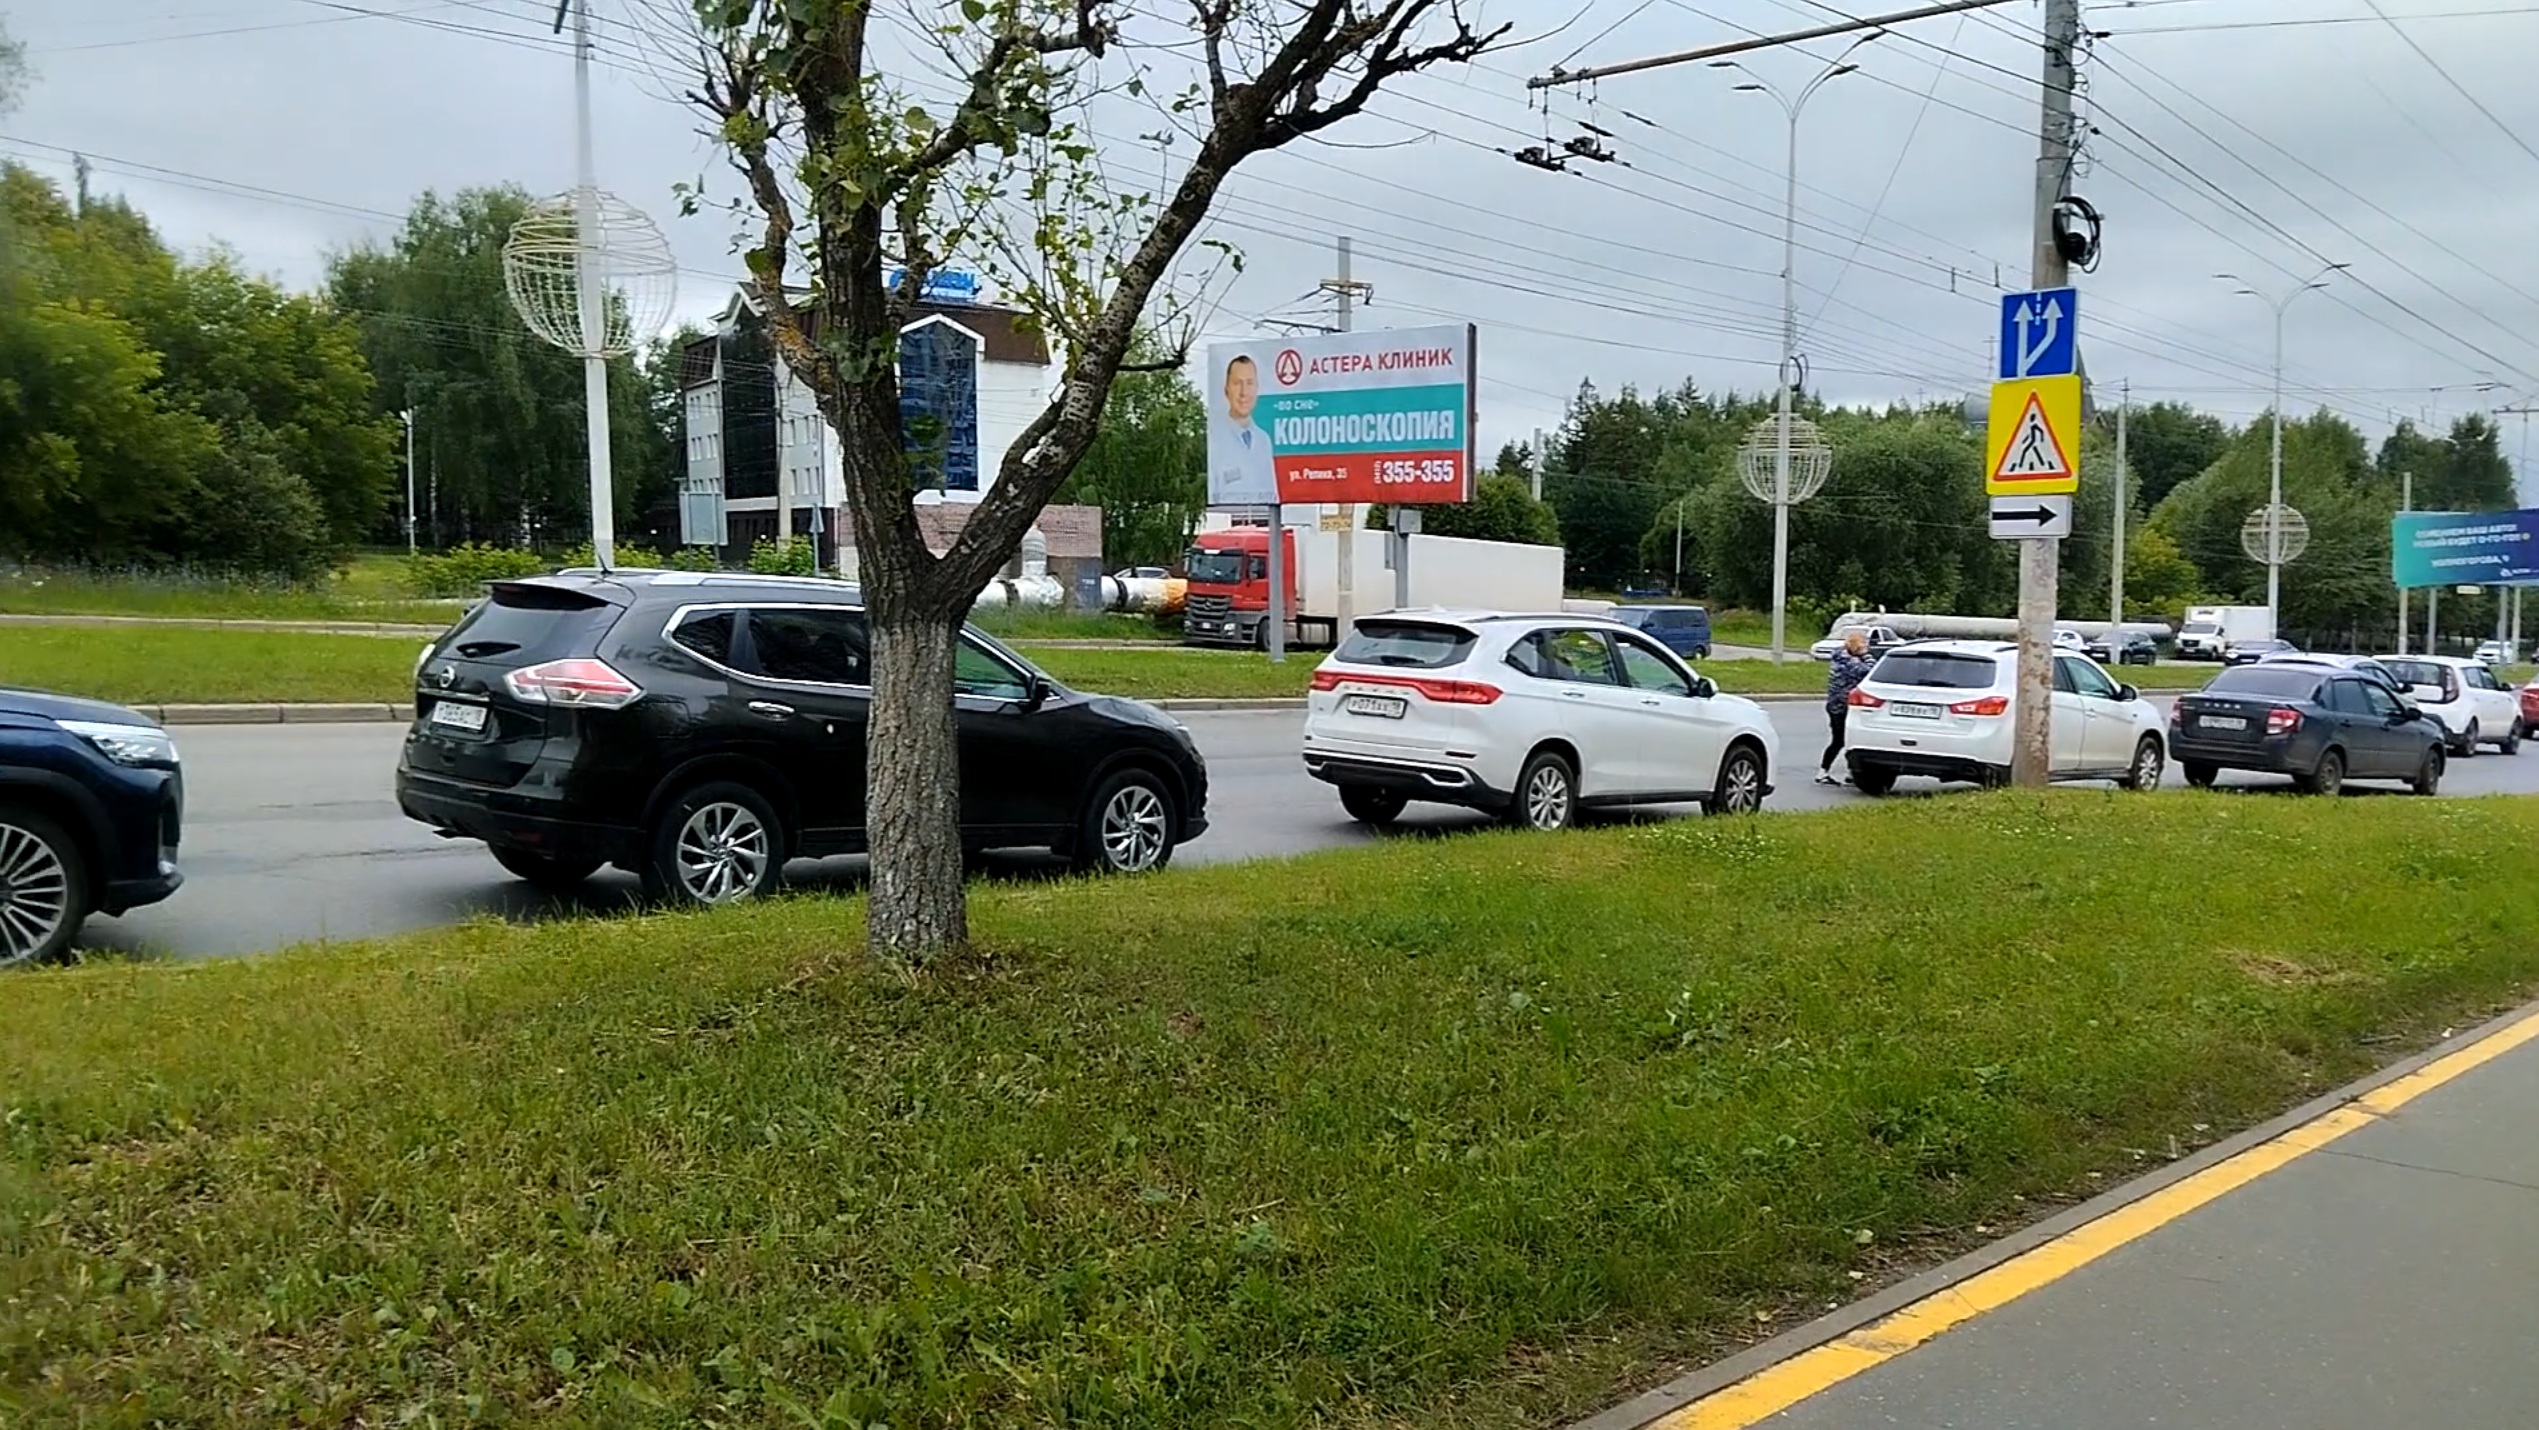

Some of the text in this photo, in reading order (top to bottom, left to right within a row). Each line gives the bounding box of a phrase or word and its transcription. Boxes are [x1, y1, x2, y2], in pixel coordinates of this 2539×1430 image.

[1309, 348, 1453, 374] АСТЕРА КЛИНИК
[1273, 410, 1455, 446] КОЛОНОСКОПИЯ
[1382, 459, 1454, 483] 355-355
